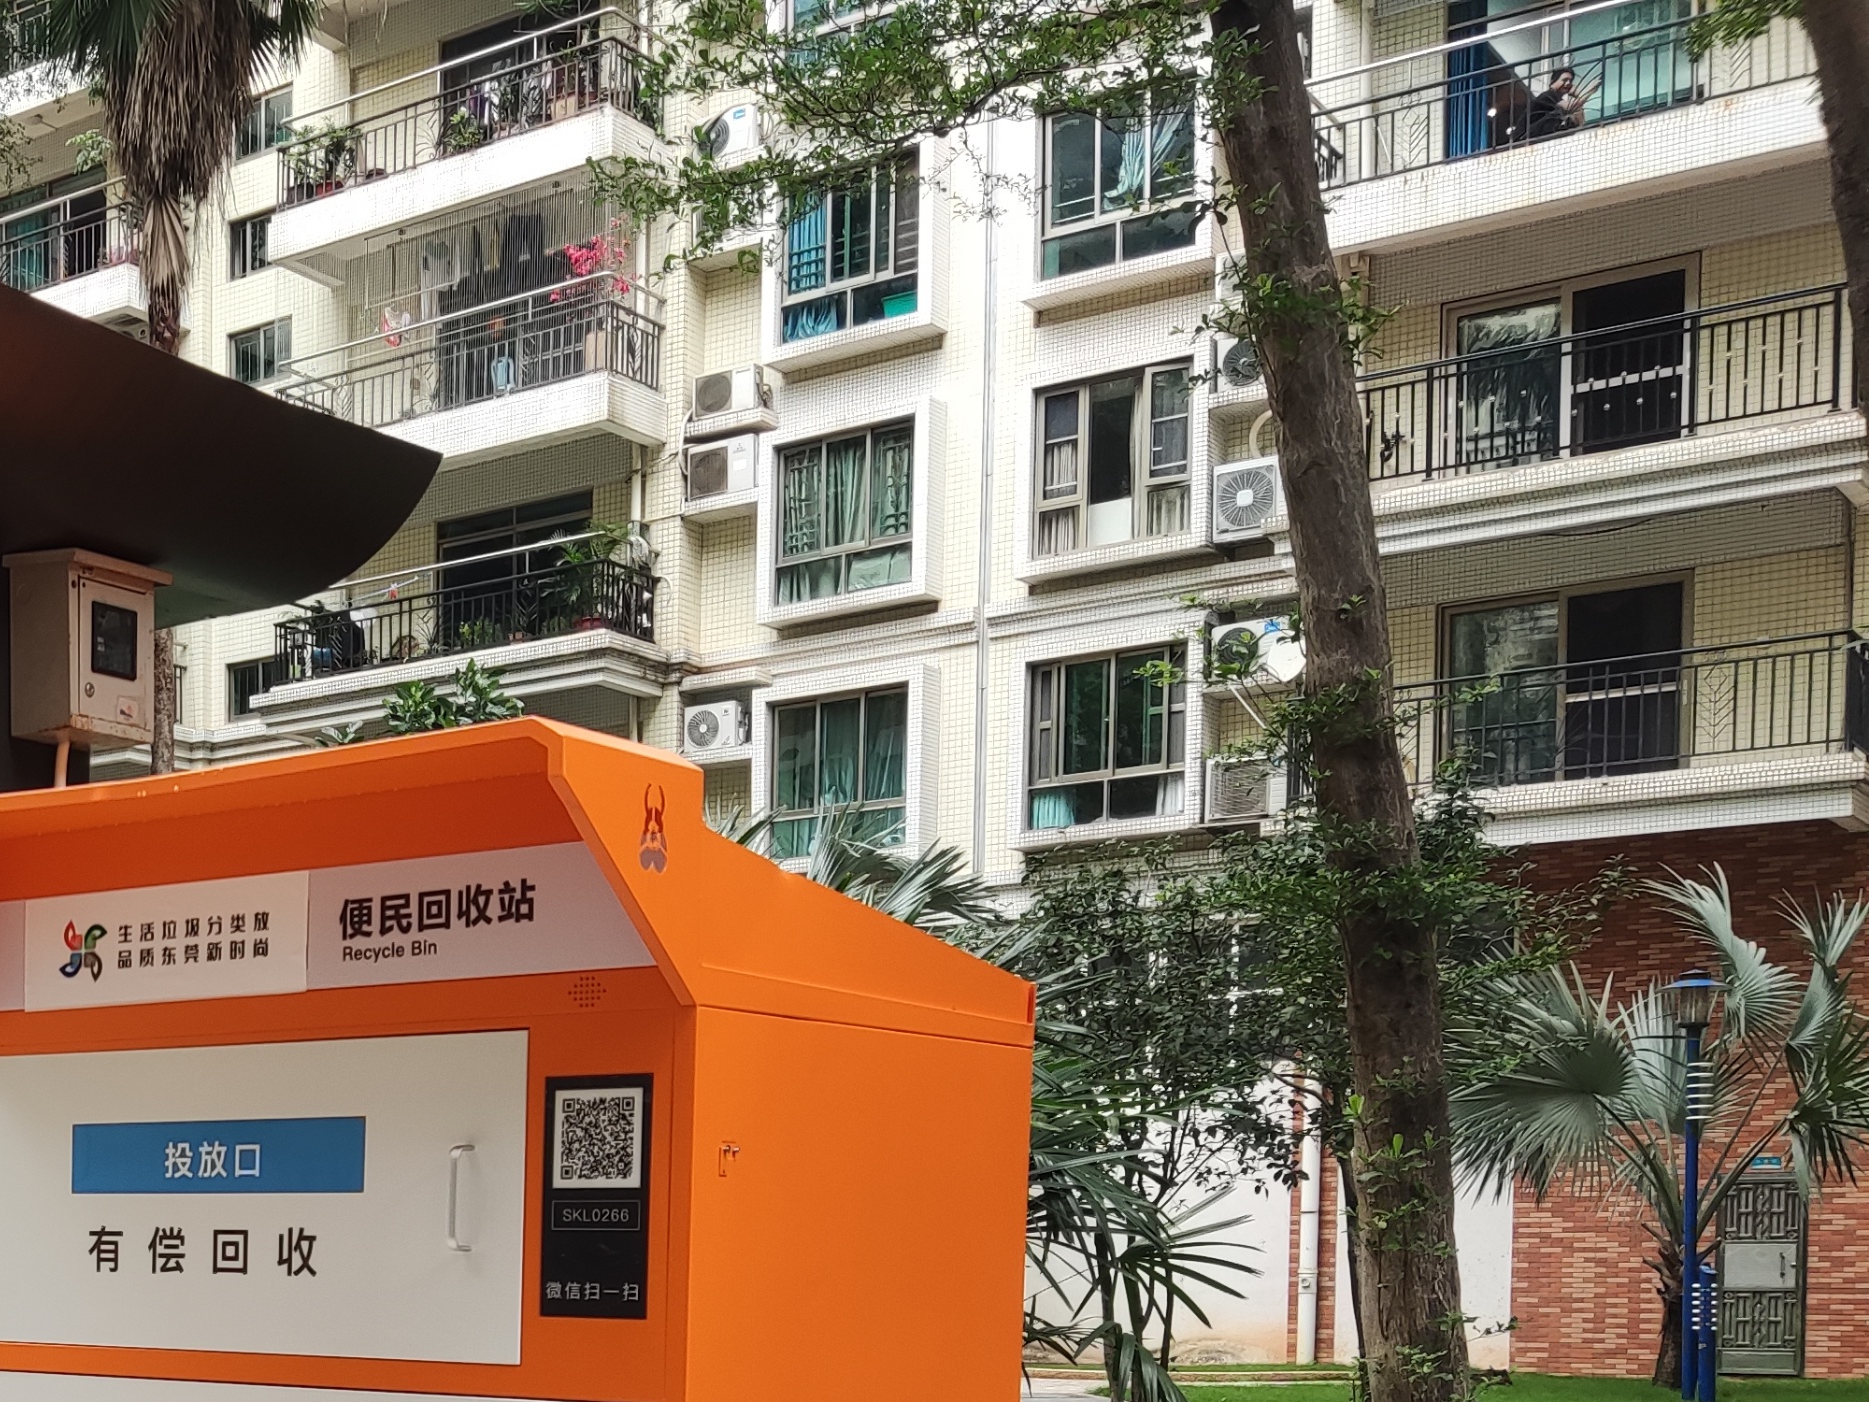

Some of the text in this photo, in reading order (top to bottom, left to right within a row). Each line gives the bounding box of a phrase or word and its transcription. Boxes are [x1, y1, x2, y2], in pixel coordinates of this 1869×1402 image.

[339, 877, 536, 941] 便民回收站
[117, 911, 270, 944] 生活垃圾分类放
[117, 937, 270, 970] 品质东莞新时尚
[342, 939, 438, 964] Recycle Bin
[164, 1140, 262, 1180] 投放口
[562, 1208, 630, 1223] SKL0266
[87, 1224, 320, 1278] 有偿回收
[545, 1281, 640, 1302] 微信扫一扫
